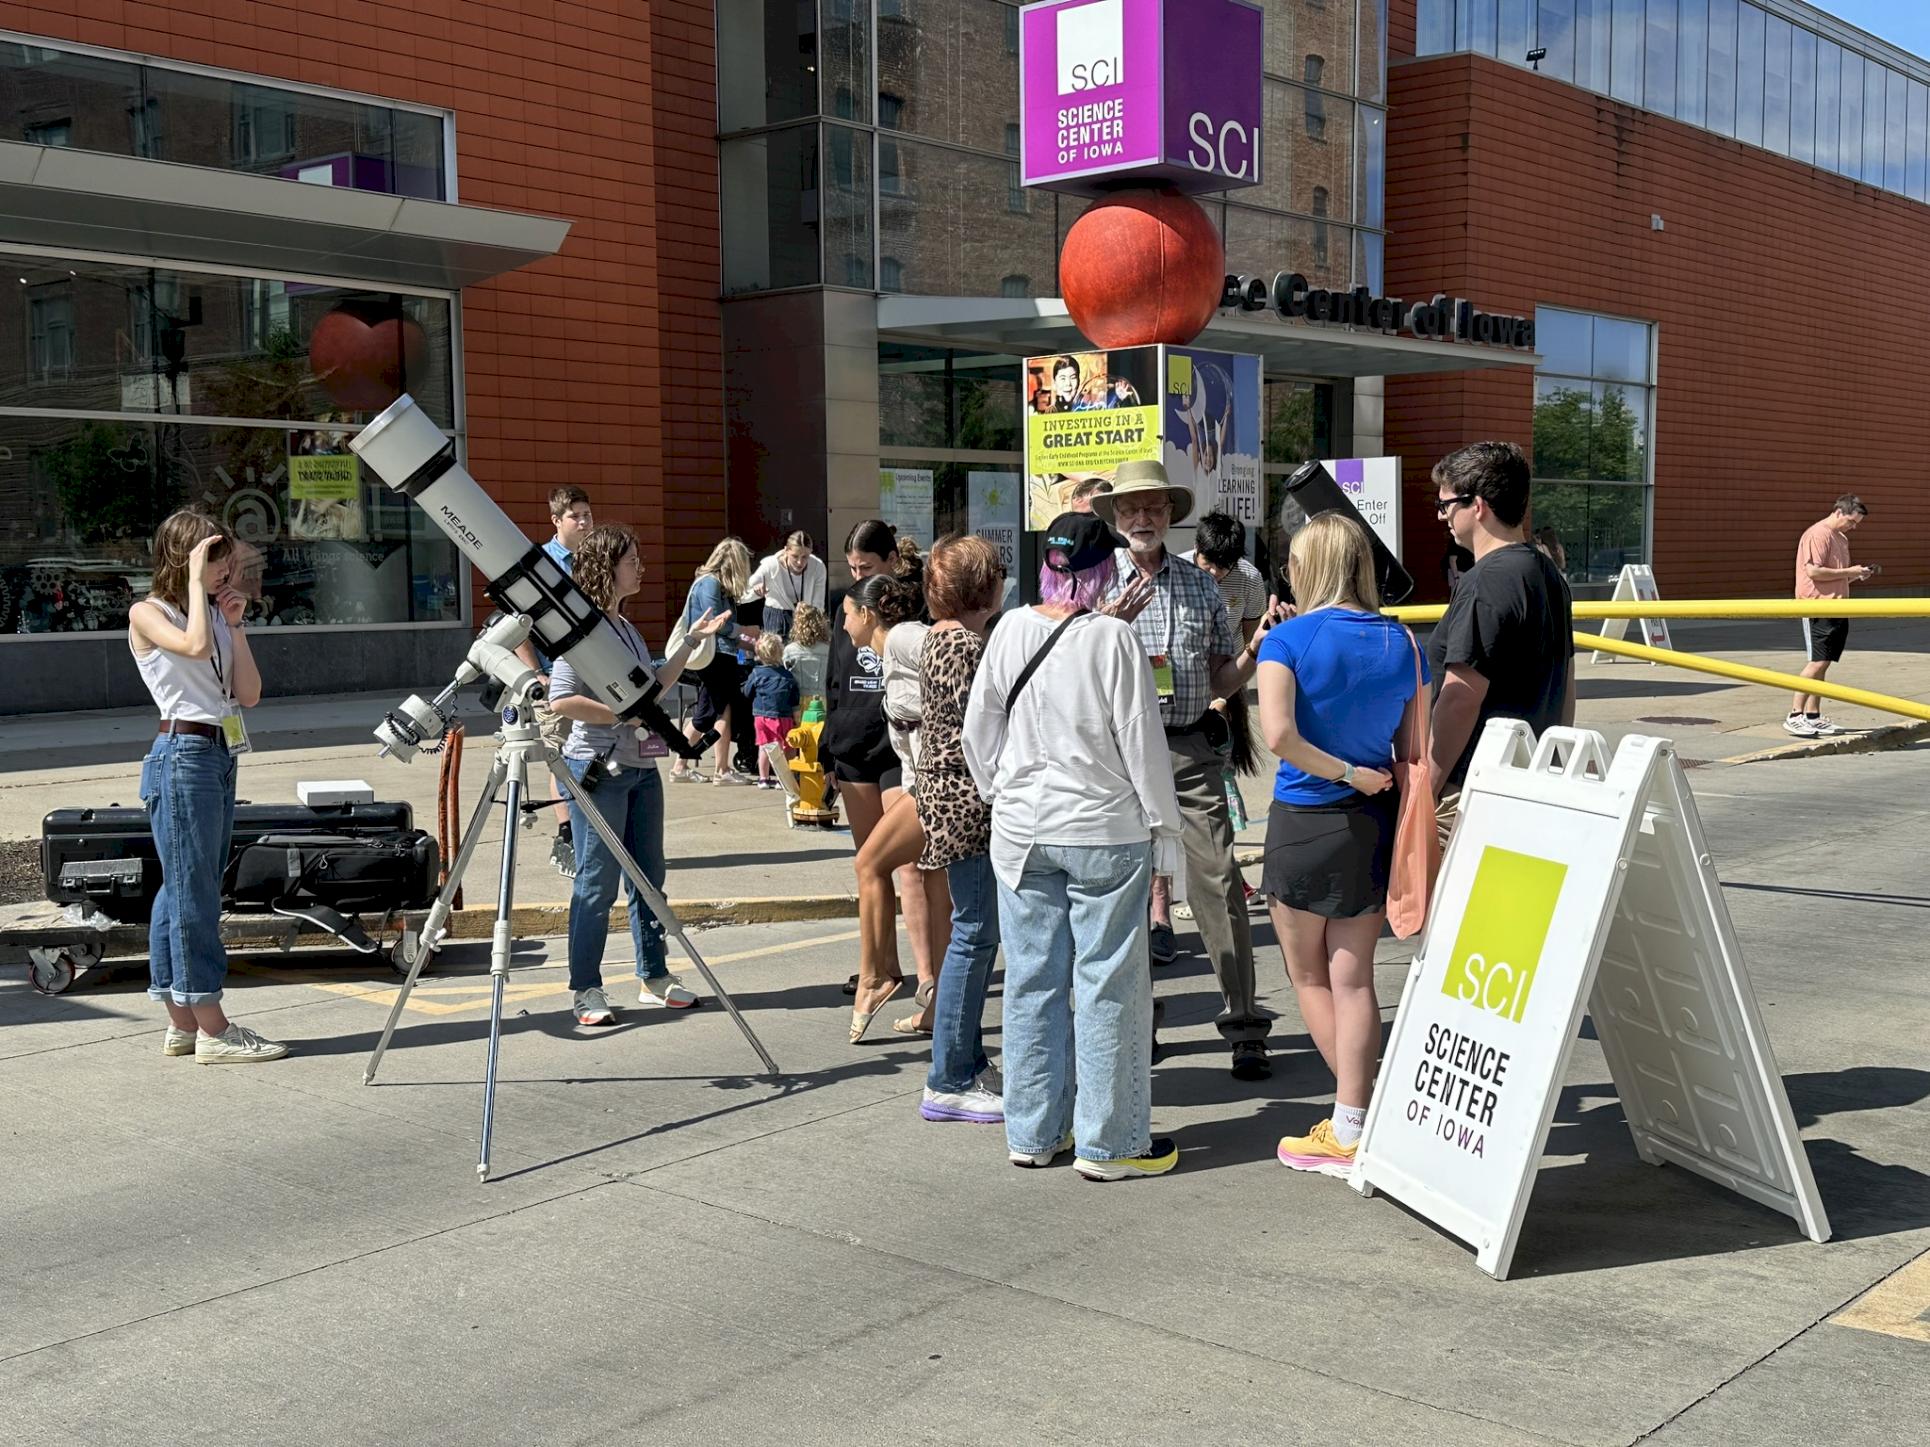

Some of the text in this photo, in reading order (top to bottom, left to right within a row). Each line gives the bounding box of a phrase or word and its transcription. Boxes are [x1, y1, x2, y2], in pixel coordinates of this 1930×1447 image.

[1071, 57, 1118, 91] SCI
[1057, 98, 1123, 128] SCIENCE
[1057, 119, 1123, 148] CENTER
[1188, 112, 1259, 182] SCI
[1057, 141, 1124, 164] OF IOWA
[1273, 271, 1408, 336] Center
[1411, 294, 1450, 341] of
[1455, 298, 1535, 350] Iowa
[1043, 413, 1144, 431] INVESTING IN A
[1043, 428, 1144, 449] GREAT START
[1218, 479, 1255, 494] LEARNING
[1342, 481, 1365, 494] SCI
[1357, 499, 1388, 511] Enter
[440, 505, 483, 550] MEADE
[1458, 953, 1527, 1022] SCI
[1424, 1023, 1510, 1087] SCIENCE
[1414, 1060, 1498, 1127] CENTER
[1407, 1099, 1486, 1158] OF IOWA
